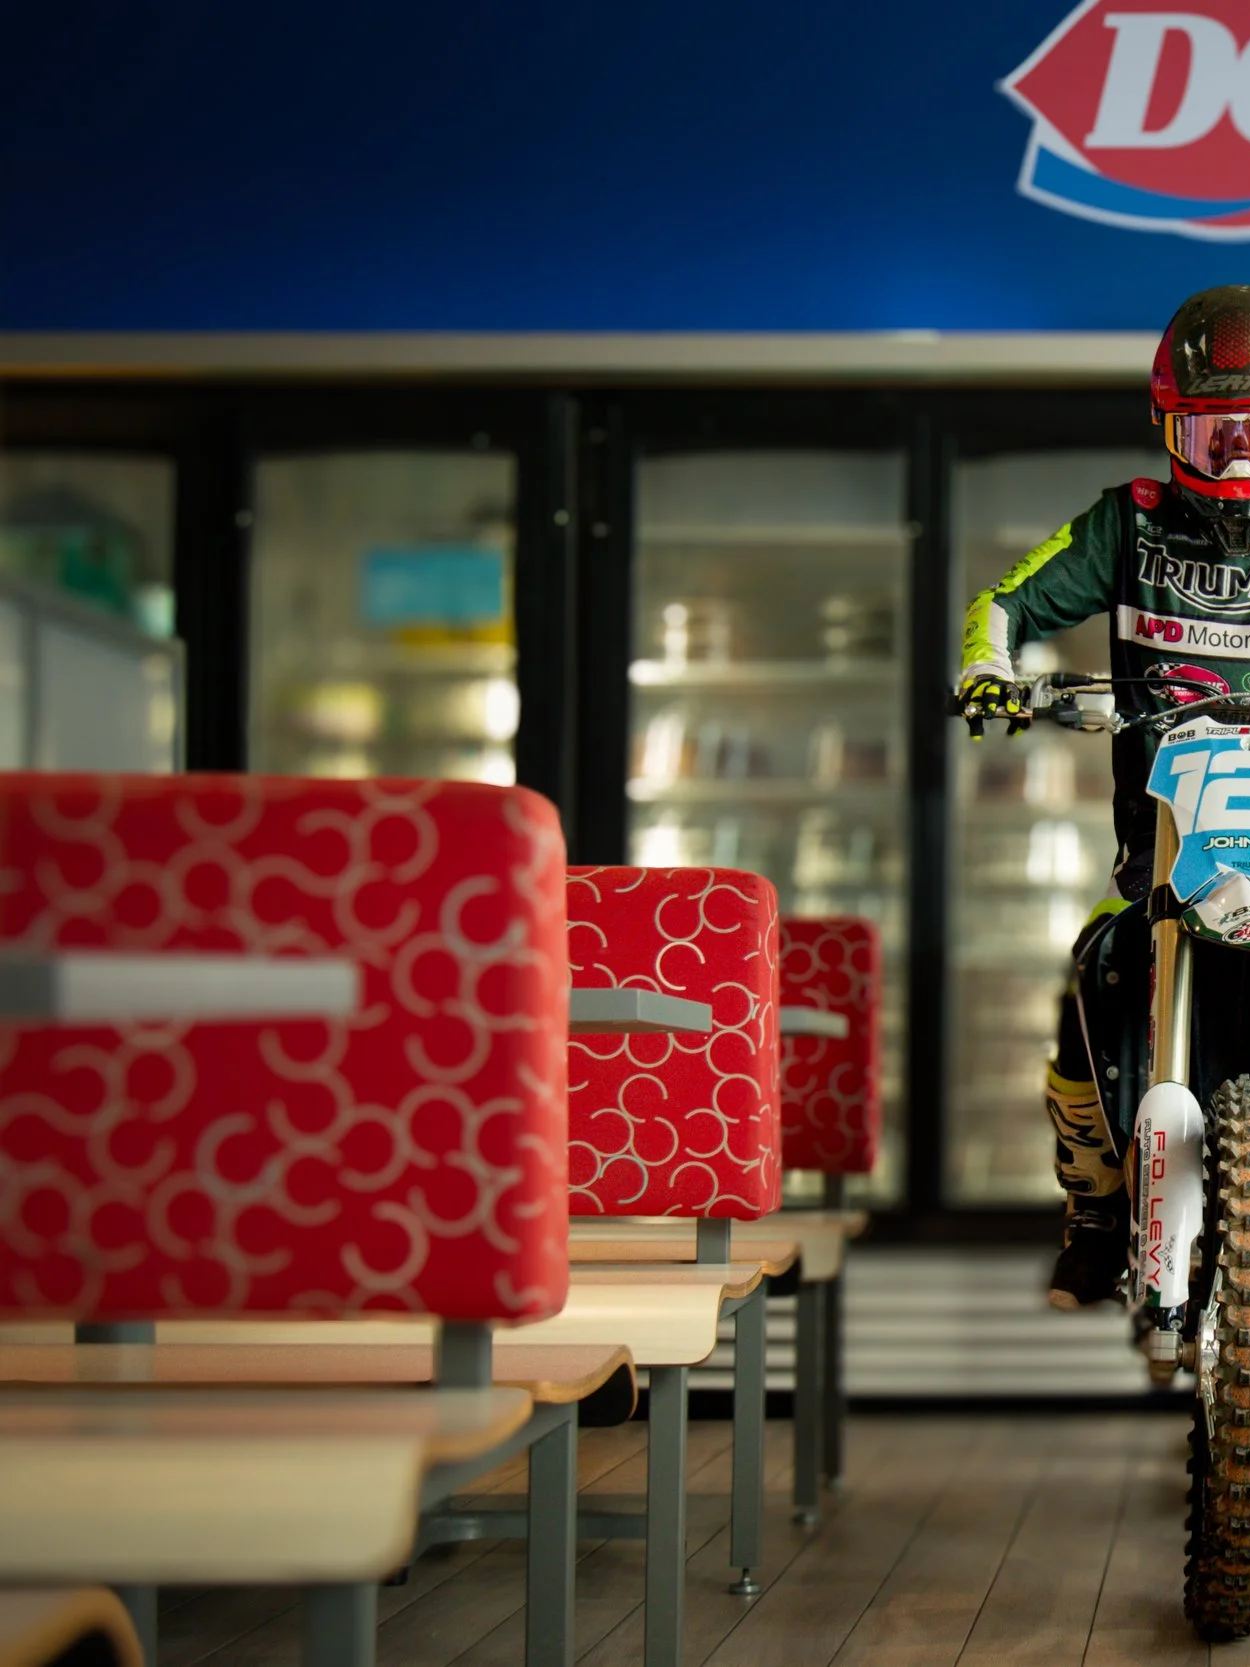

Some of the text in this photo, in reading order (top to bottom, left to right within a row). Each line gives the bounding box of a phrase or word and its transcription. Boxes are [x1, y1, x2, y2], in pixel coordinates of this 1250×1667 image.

[1135, 614, 1184, 643] APD
[1206, 727, 1249, 736] TRIPL
[1143, 1117, 1152, 1161] AUTO
[1147, 1198, 1164, 1287] LEVY
